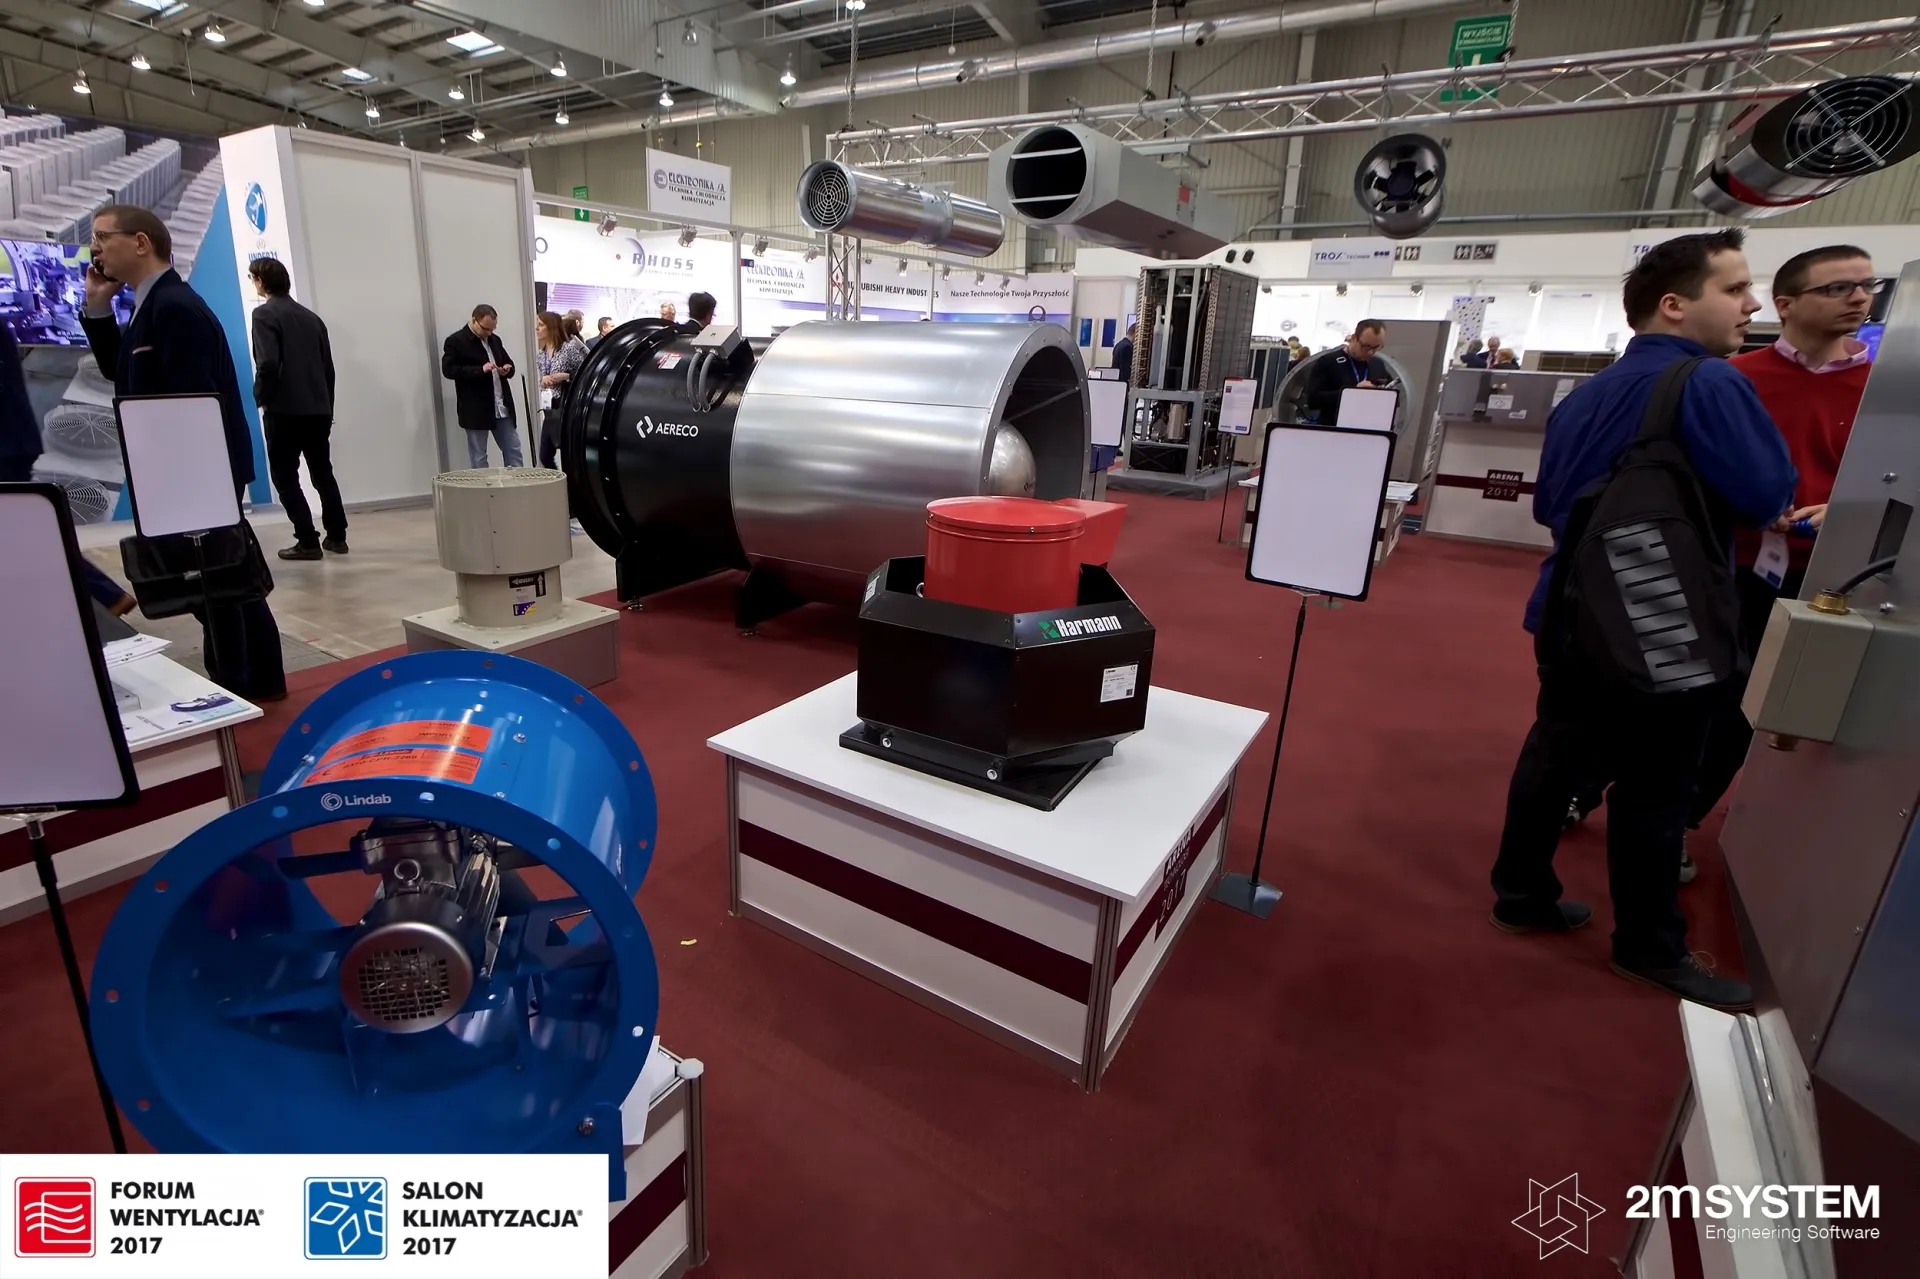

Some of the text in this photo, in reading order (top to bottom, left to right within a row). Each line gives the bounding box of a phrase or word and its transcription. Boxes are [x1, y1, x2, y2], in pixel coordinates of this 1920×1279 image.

[668, 185, 693, 196] TECHNIKA
[681, 195, 714, 206] KLIMATYZACJA
[632, 252, 694, 270] RHOSS
[884, 285, 905, 295] HEAVY
[970, 290, 1009, 299] Technologie
[1011, 290, 1031, 298] Twoja
[1032, 289, 1070, 299] Przyszłość
[655, 422, 699, 438] AERECO
[1489, 472, 1520, 482] ARENA
[1485, 486, 1517, 497] 2017
[1057, 615, 1121, 637] Harmann
[344, 793, 392, 807] Lindab
[1159, 868, 1187, 923] 2017
